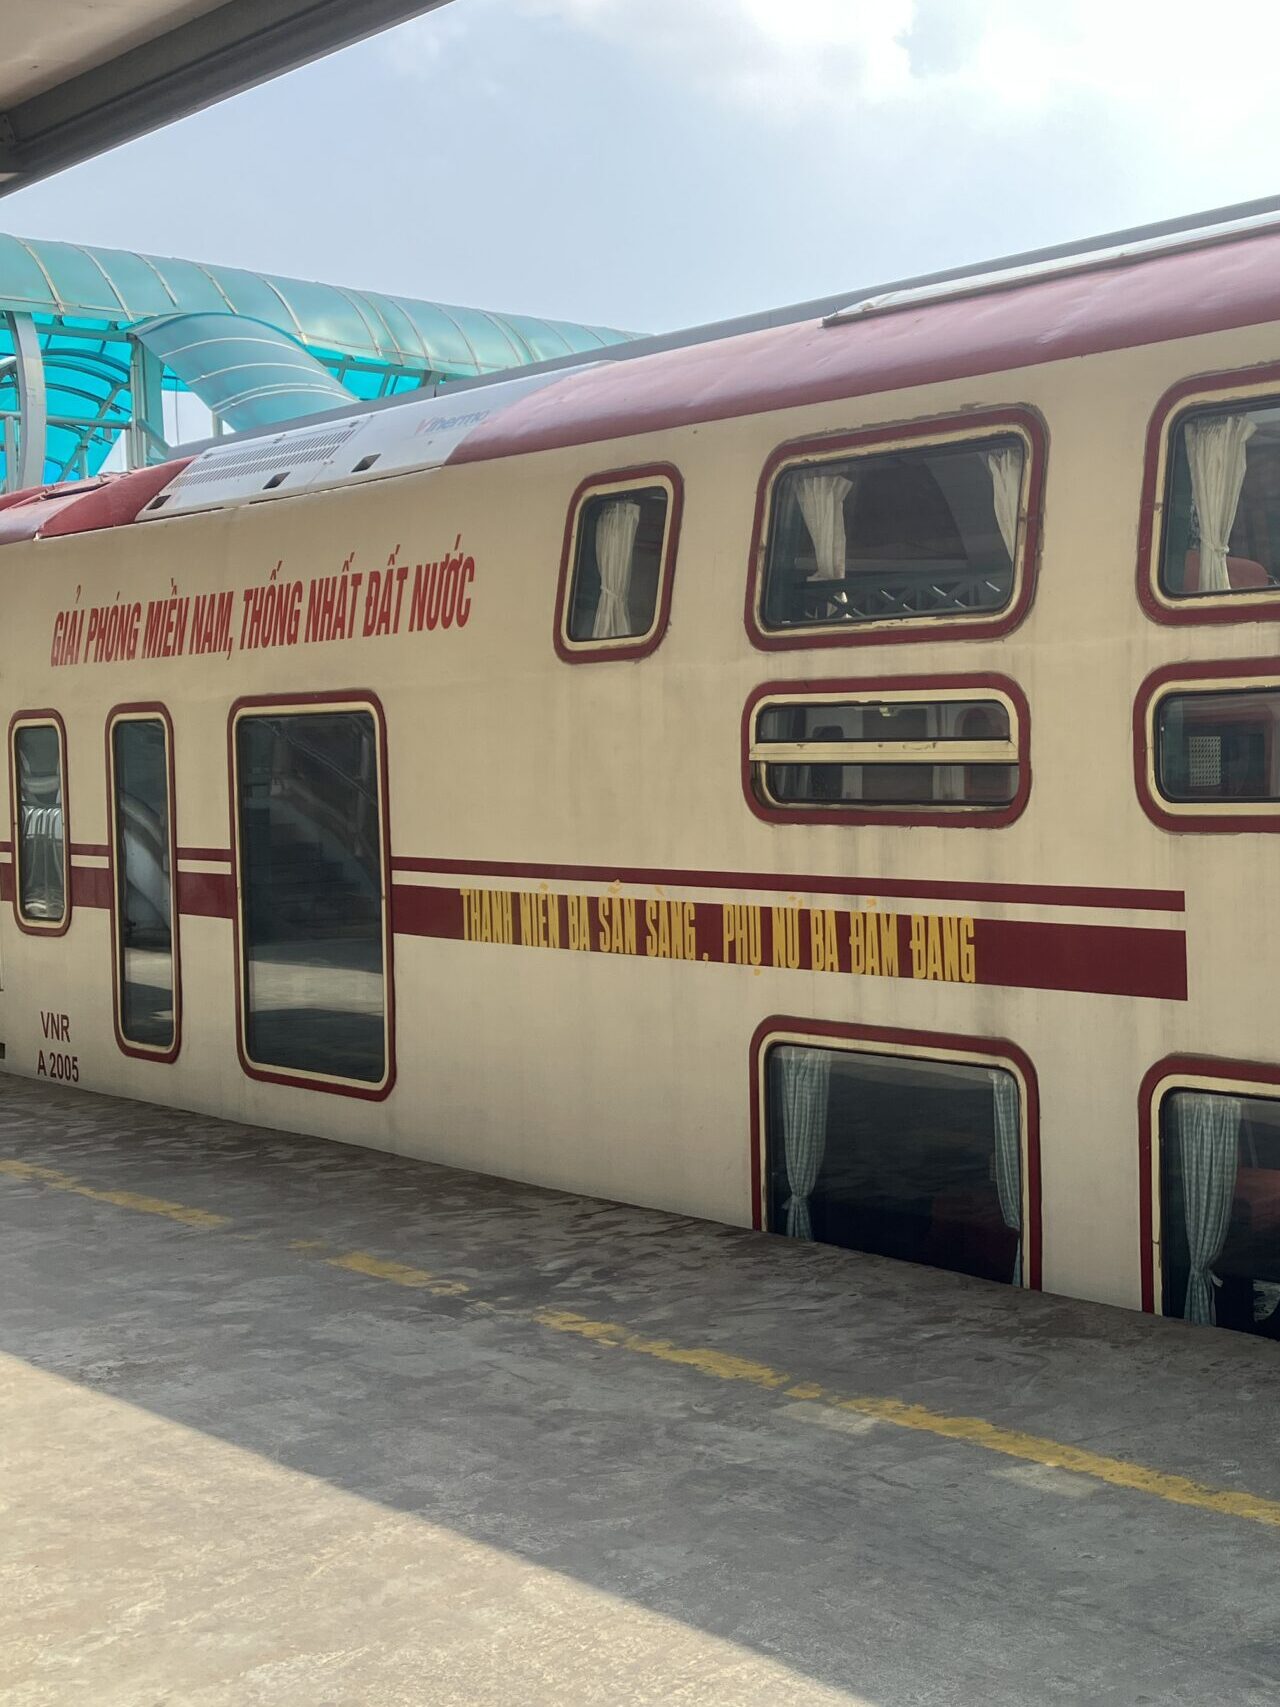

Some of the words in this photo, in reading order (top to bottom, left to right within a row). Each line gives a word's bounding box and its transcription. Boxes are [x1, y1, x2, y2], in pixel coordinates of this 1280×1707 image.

[51, 584, 84, 667] GIẢI
[83, 591, 142, 663] PHÓNG
[141, 577, 190, 660] MIỀN
[189, 590, 234, 661] NAM,
[239, 560, 303, 650] THỐNG
[304, 552, 363, 643] NHẤT
[362, 544, 409, 637] ĐẤT
[408, 533, 475, 632] NƯỚC
[460, 888, 513, 945] THANH
[519, 882, 560, 949] NIÊN
[567, 893, 591, 951] BA
[722, 903, 762, 976] PHỤ
[810, 907, 840, 972] BA
[909, 911, 976, 983] ĐANG
[40, 1010, 71, 1043] VNR
[37, 1049, 47, 1076] A
[49, 1052, 79, 1082] 2005
